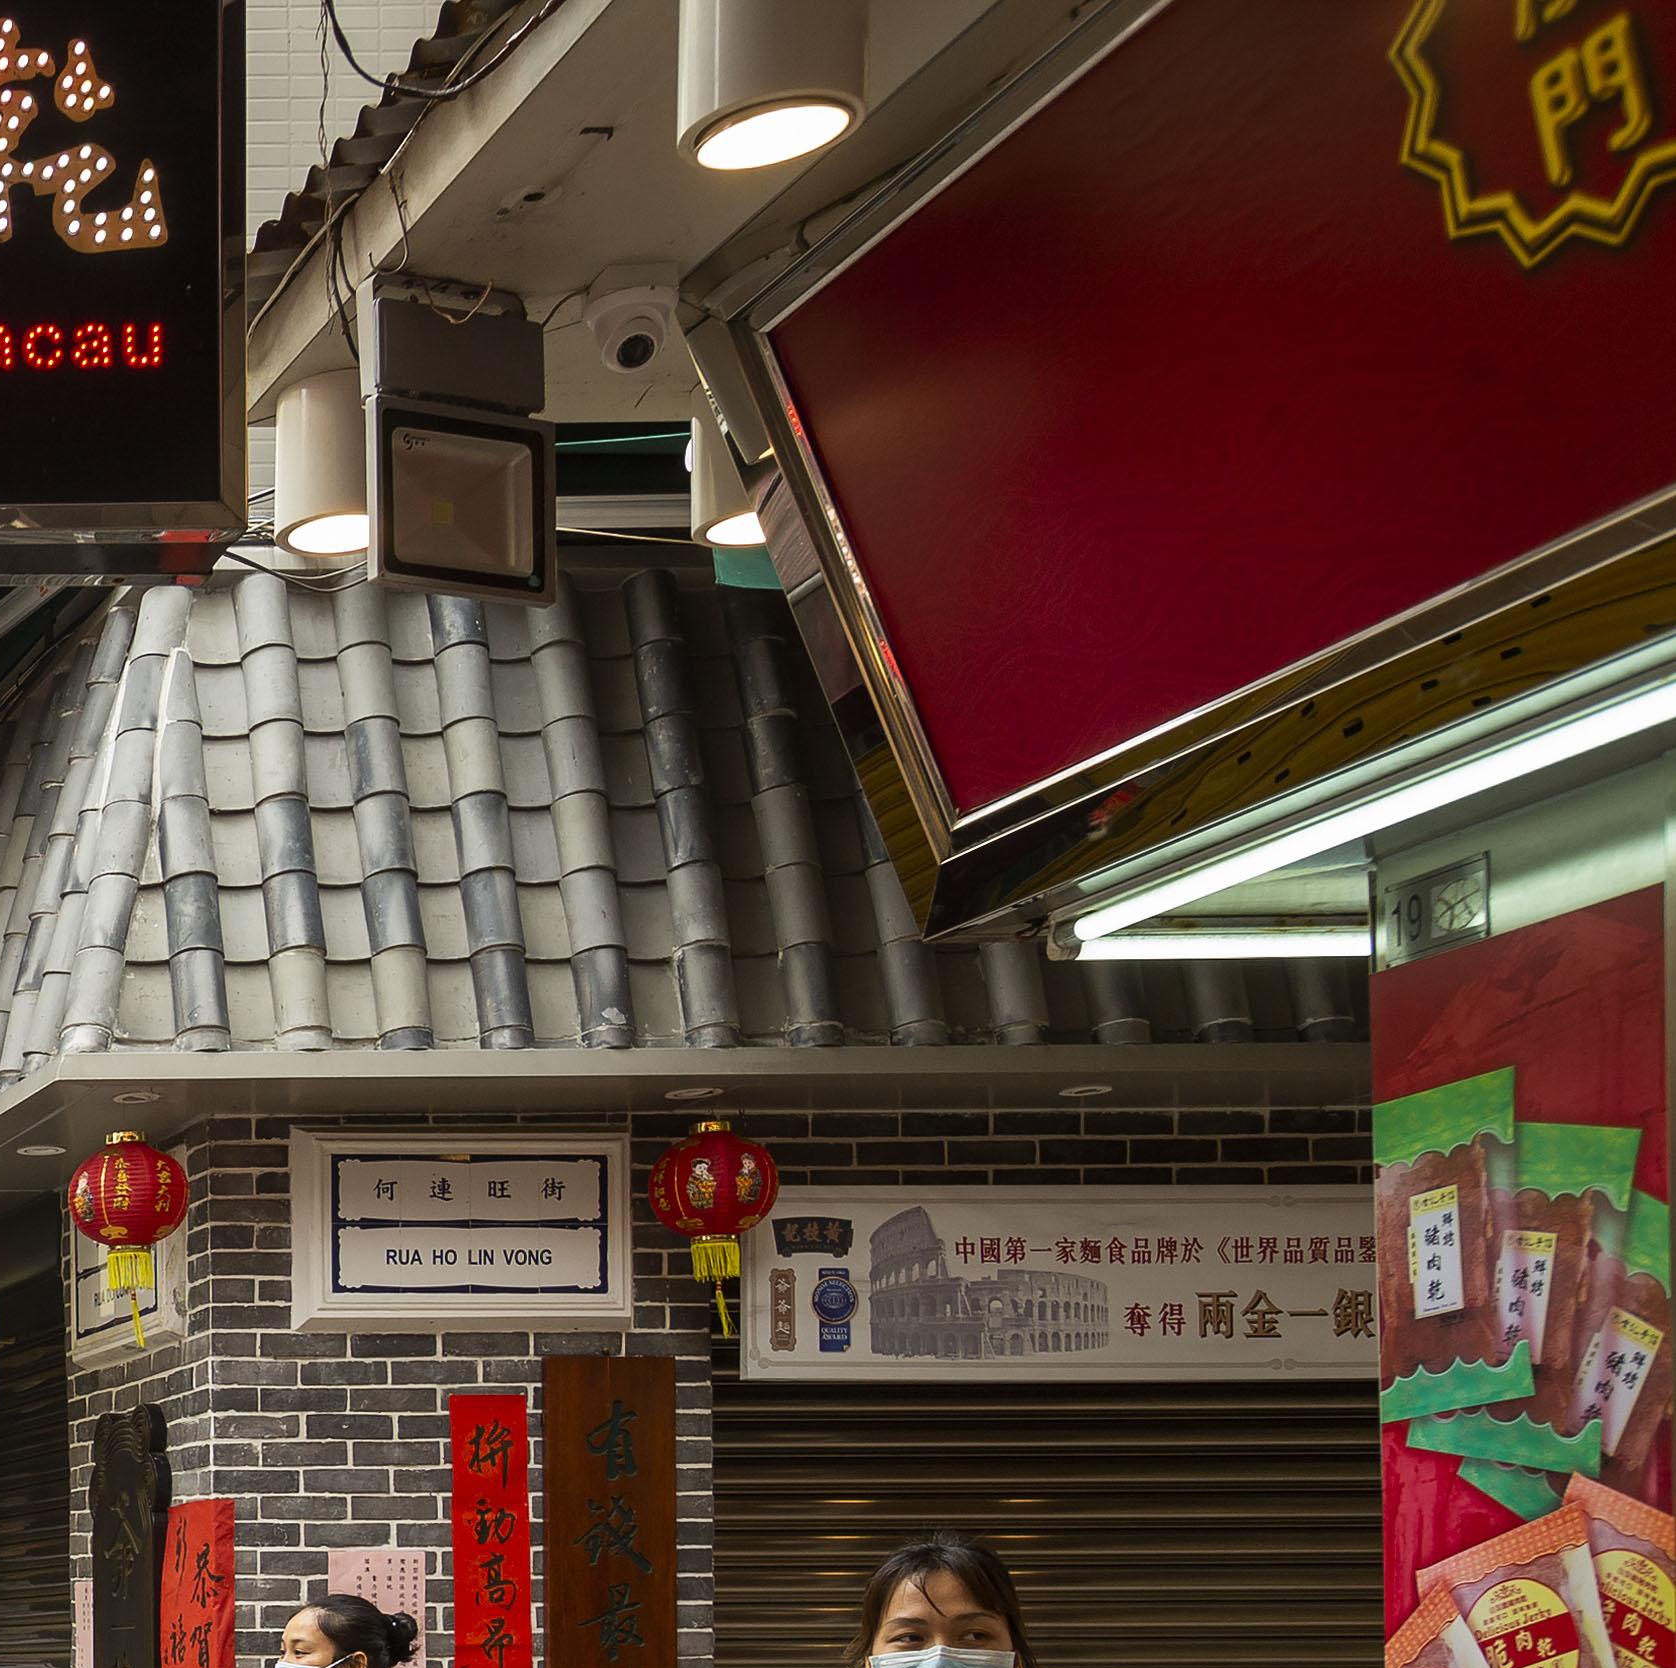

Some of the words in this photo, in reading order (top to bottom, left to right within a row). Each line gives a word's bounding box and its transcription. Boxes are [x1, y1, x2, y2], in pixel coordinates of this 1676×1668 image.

[373, 1177, 566, 1203] 何連旺街
[386, 1248, 424, 1267] RUA
[432, 1247, 459, 1267] HO
[467, 1247, 496, 1267] LIN
[503, 1247, 553, 1267] VONG
